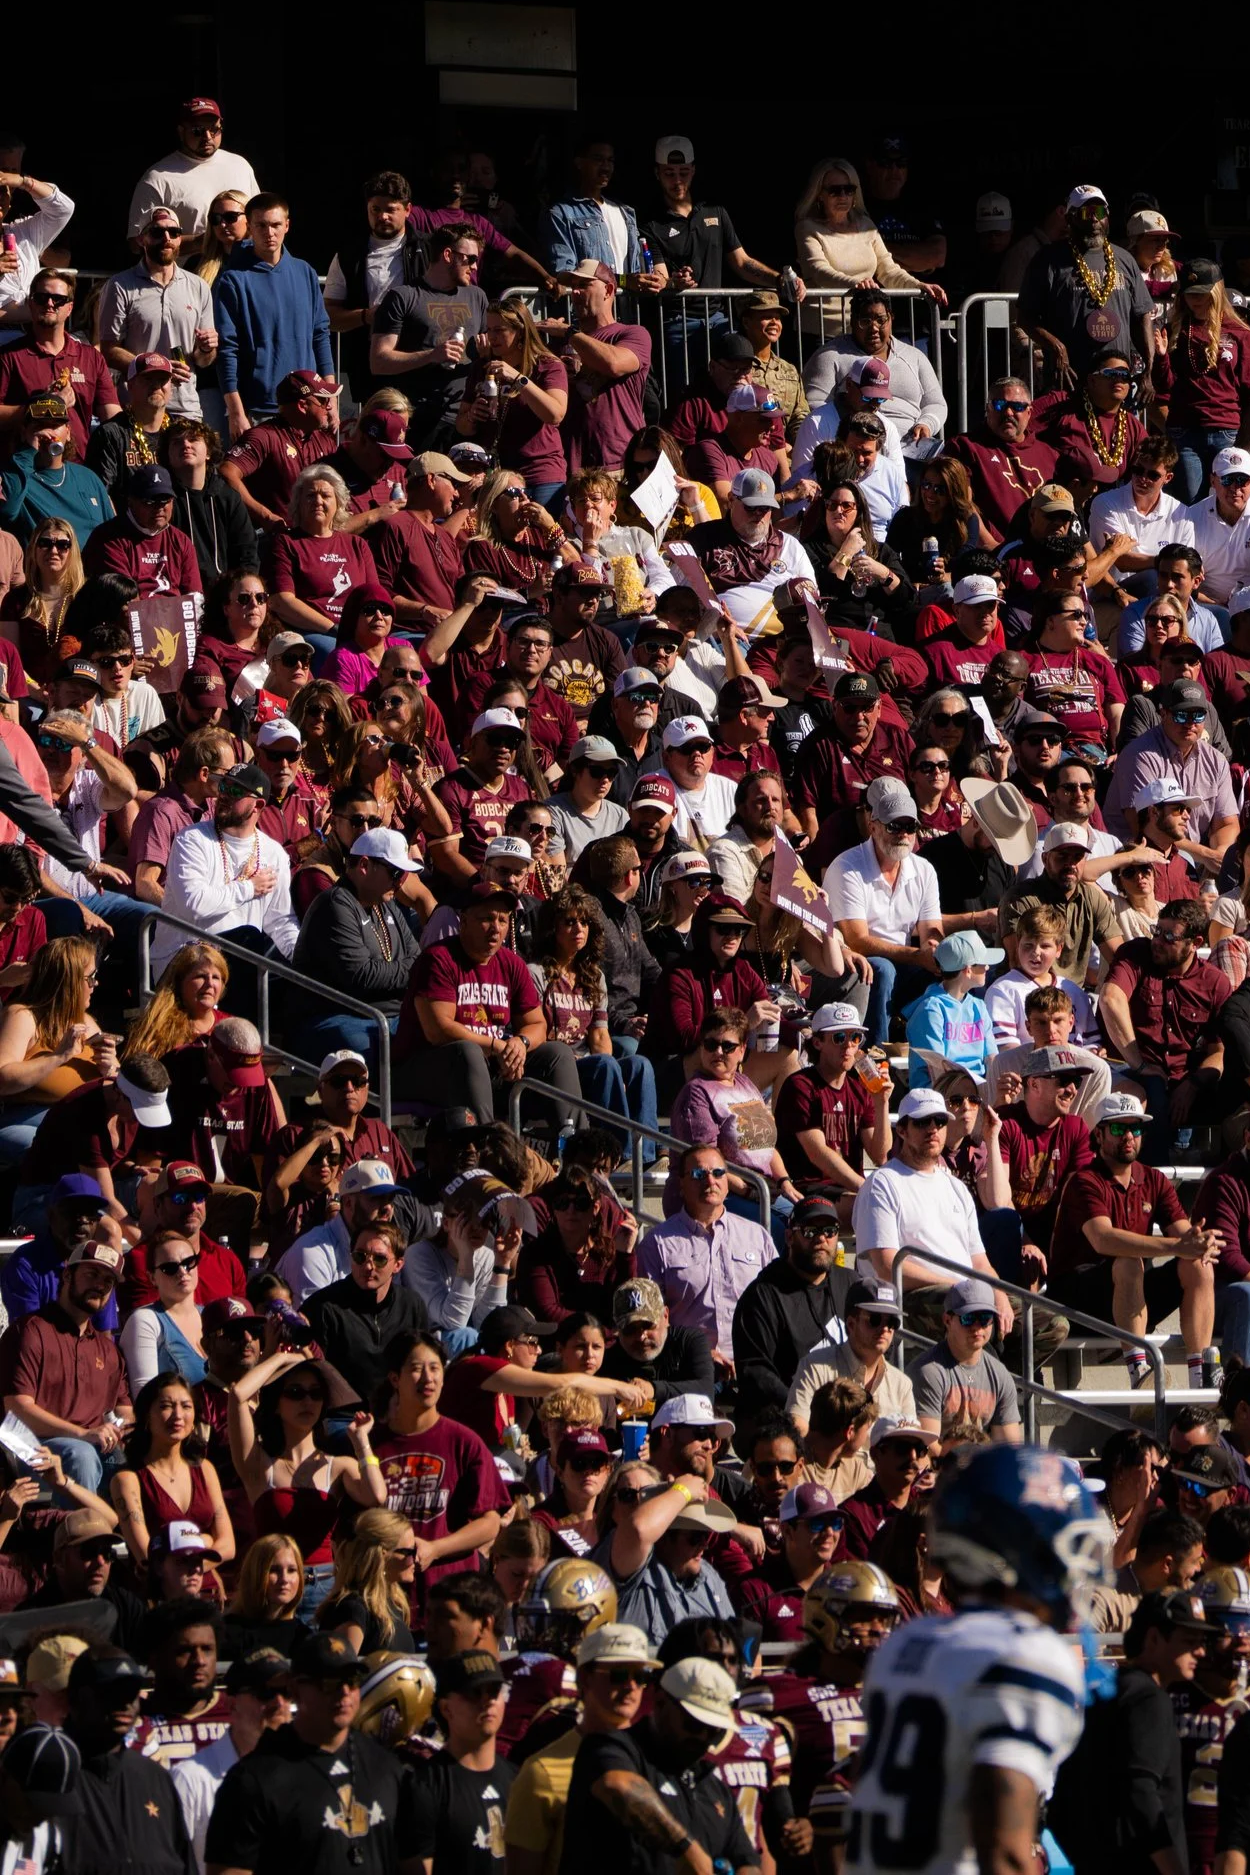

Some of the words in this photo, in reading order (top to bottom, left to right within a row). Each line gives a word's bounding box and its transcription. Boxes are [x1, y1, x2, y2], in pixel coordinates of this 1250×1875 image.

[1090, 324, 1116, 332] TEXAS
[1091, 331, 1116, 339] STATE
[182, 600, 194, 623] GO
[542, 658, 607, 693] BOBCATS
[641, 783, 670, 797] BOBCATS
[777, 894, 793, 912] BOWL
[792, 902, 804, 918] FOR
[802, 908, 815, 924] THE
[811, 913, 829, 933] BRAVE
[457, 983, 482, 1005] TEXAS
[481, 982, 509, 1008] STATE
